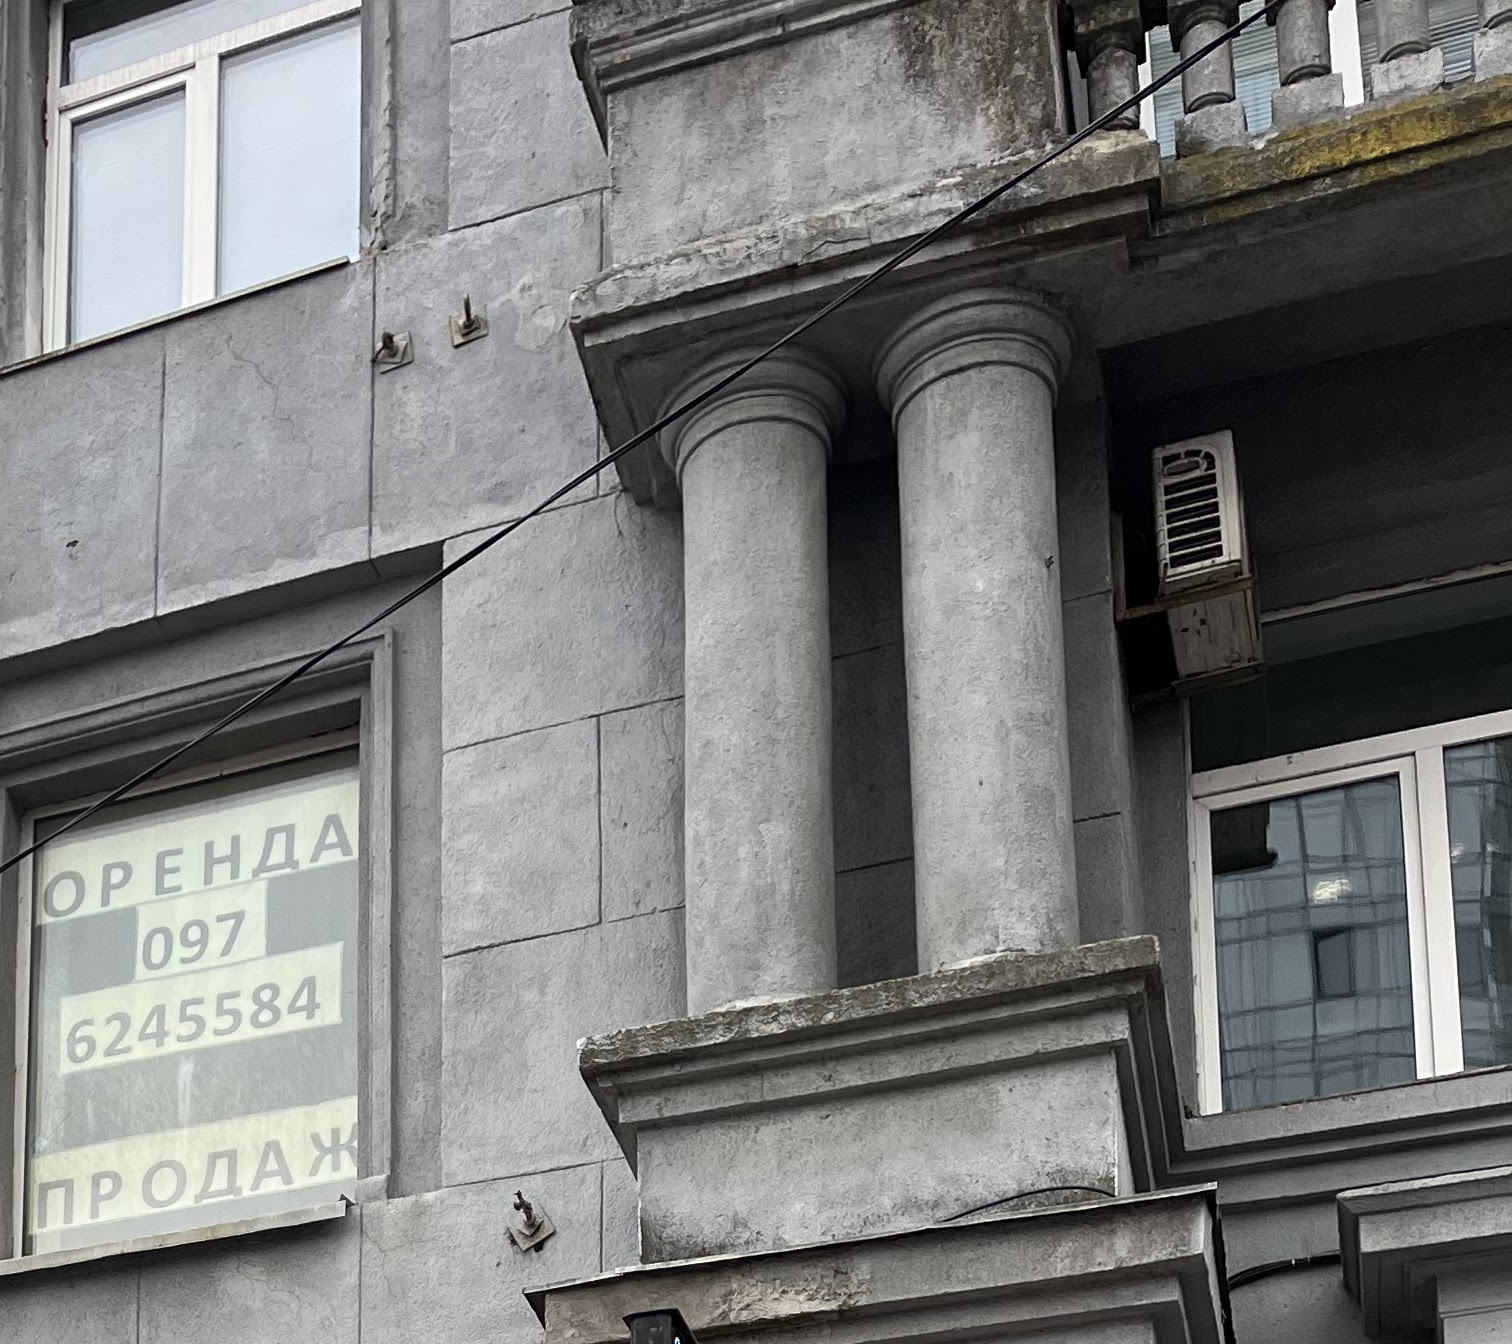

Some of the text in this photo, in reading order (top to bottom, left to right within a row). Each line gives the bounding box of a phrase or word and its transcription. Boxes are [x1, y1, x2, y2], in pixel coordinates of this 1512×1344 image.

[42, 812, 354, 919] ОРЕНДА
[141, 909, 246, 971] 097
[66, 975, 322, 1064] 6245584
[37, 1121, 358, 1229] ПРОДАЖ
